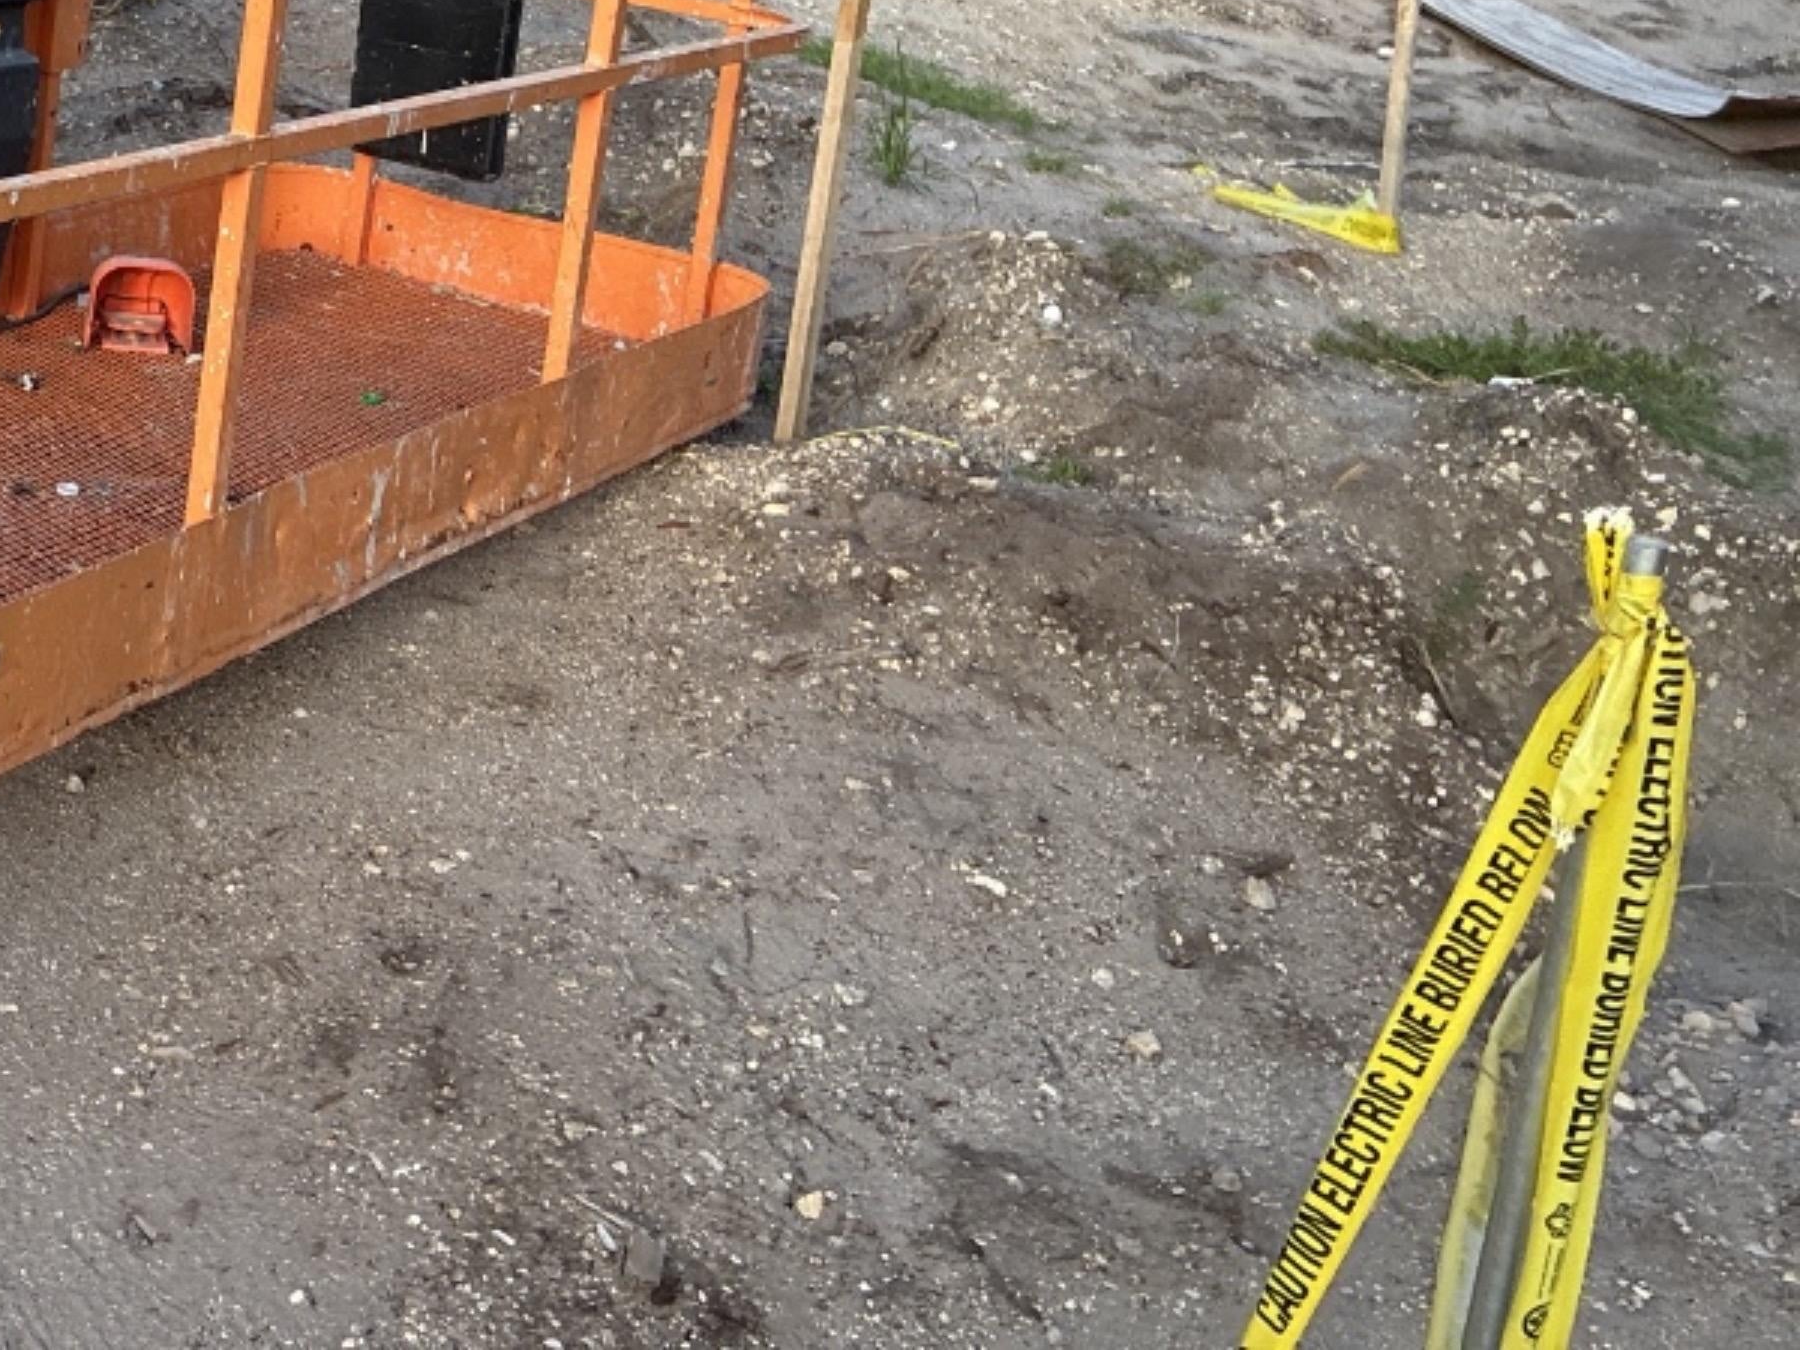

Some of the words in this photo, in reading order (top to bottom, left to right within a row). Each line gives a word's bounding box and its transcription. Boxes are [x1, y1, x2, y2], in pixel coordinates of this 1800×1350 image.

[1256, 1201, 1344, 1335] CAUTION
[1310, 1070, 1414, 1217] ELECTRIC
[1377, 1003, 1450, 1079] LINE
[1416, 898, 1504, 1013] BURIED
[1476, 786, 1554, 905] BELOW
